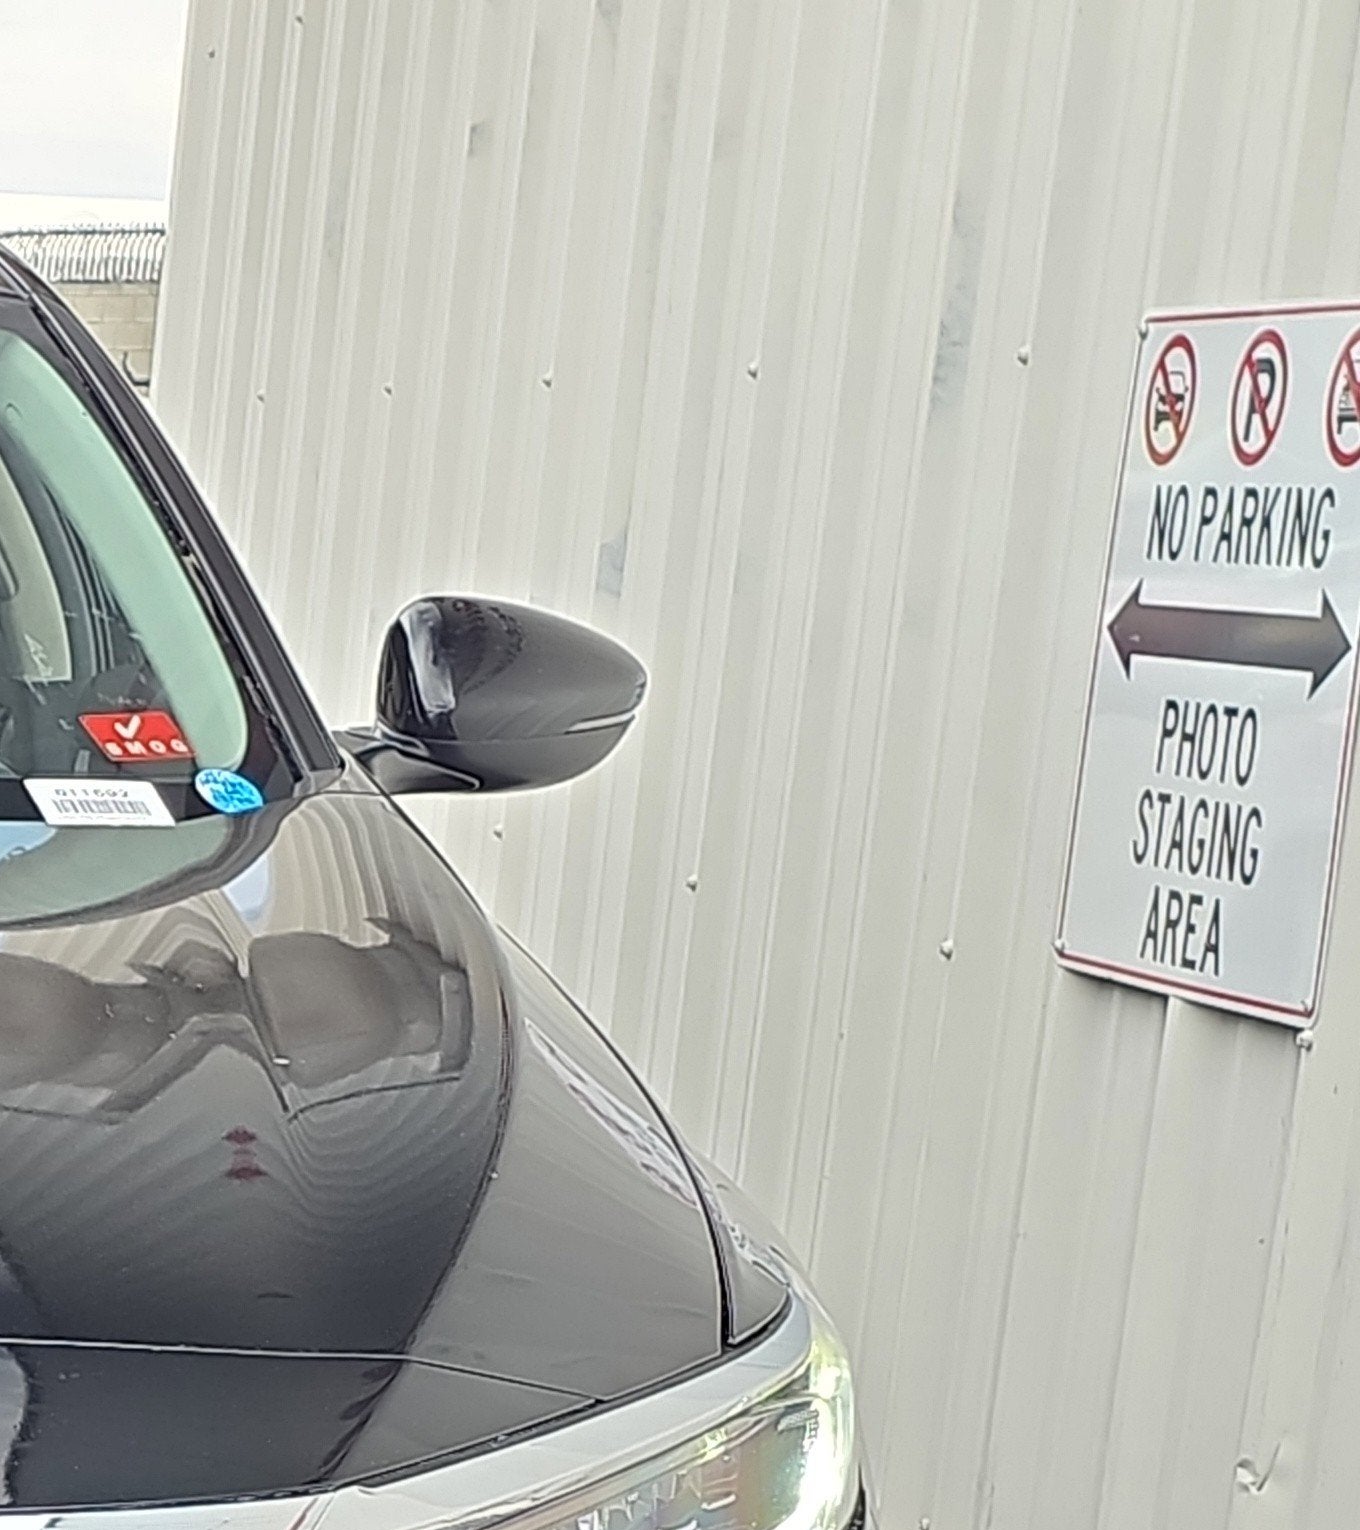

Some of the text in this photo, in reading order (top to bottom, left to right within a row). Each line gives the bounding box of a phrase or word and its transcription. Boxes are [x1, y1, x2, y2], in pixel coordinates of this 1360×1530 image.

[1146, 484, 1336, 569] NO PARKING
[1155, 699, 1258, 786] PHOTO
[1132, 788, 1262, 885] STAGING
[1139, 884, 1221, 976] AREA
